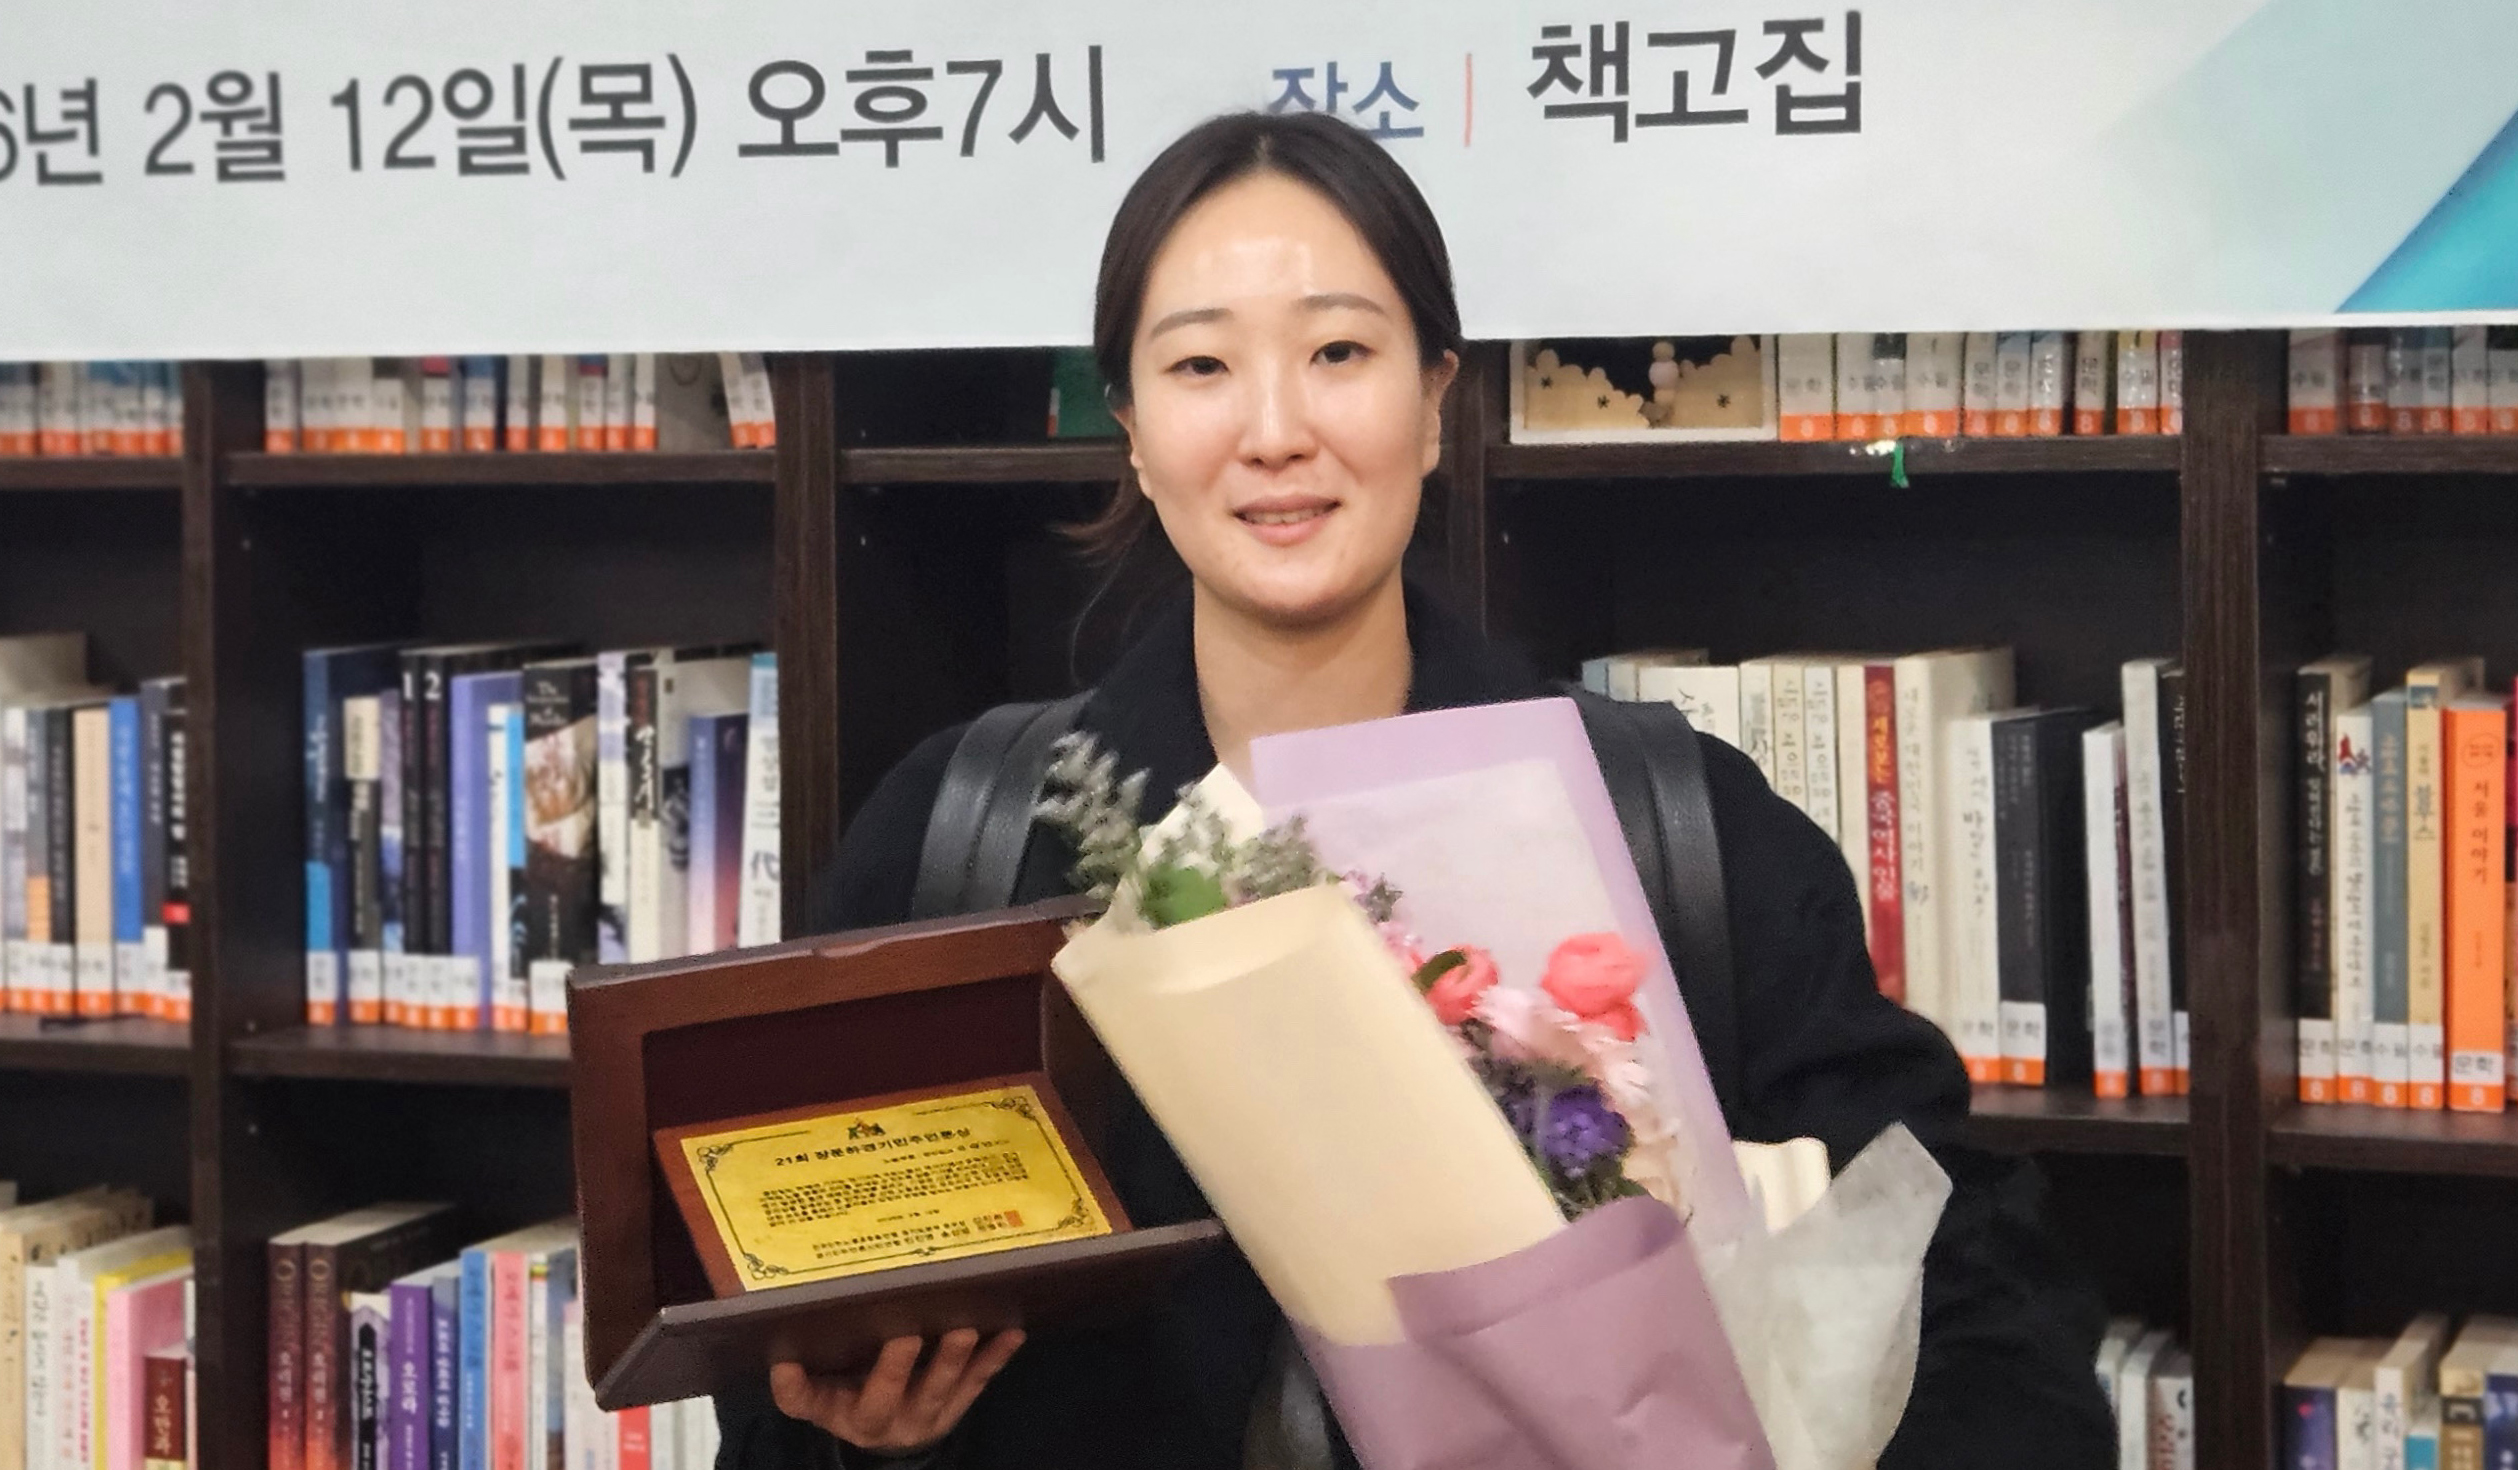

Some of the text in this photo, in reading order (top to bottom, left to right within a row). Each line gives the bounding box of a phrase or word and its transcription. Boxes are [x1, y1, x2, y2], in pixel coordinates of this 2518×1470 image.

[145, 70, 285, 183] 2월
[330, 53, 697, 181] 12일(목)
[738, 45, 1105, 168] 오후7시
[1527, 10, 1862, 143] 책고집
[402, 671, 413, 700] 1
[424, 670, 442, 700] 2
